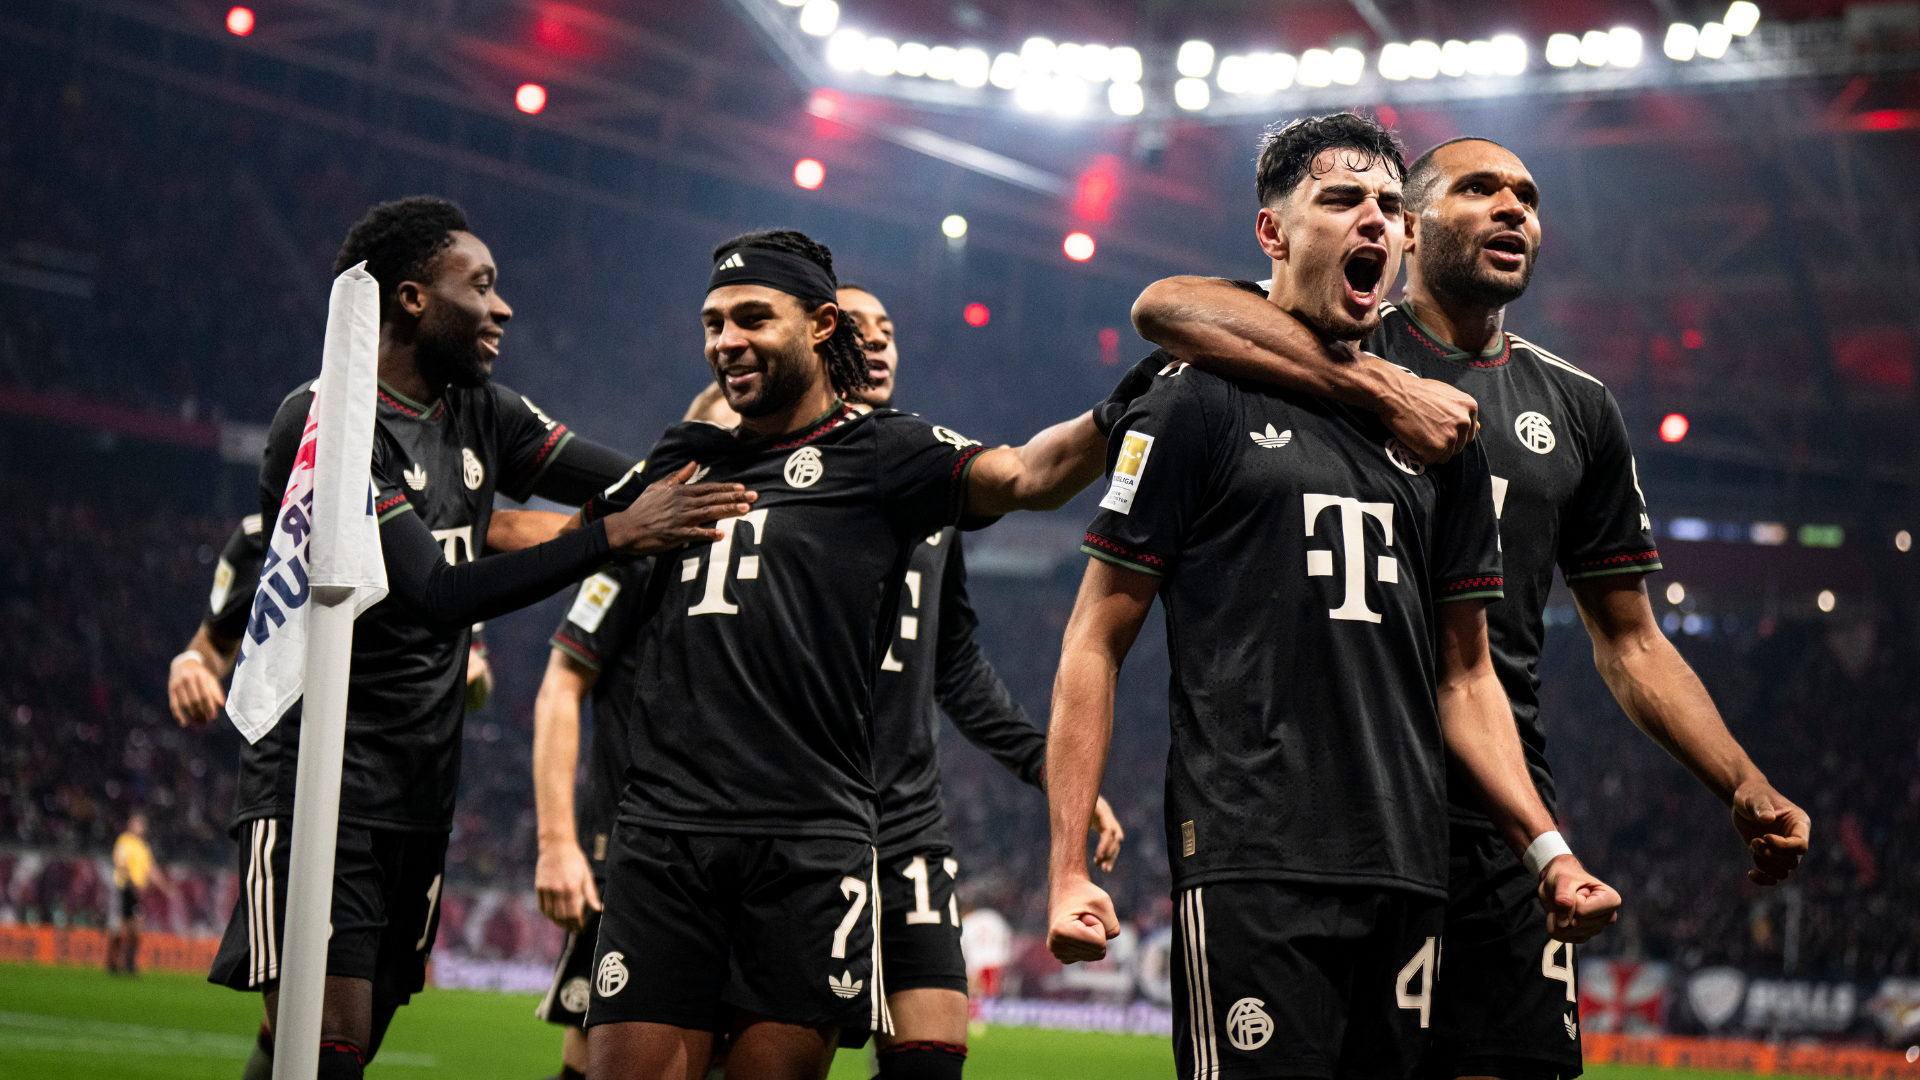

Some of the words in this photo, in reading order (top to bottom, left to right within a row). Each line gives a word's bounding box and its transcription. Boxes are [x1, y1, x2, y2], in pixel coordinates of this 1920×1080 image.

[681, 508, 769, 616] T
[1303, 493, 1399, 624] T
[831, 876, 868, 959] 7
[1396, 935, 1442, 1029] 4
[1541, 938, 1577, 1003] 4
